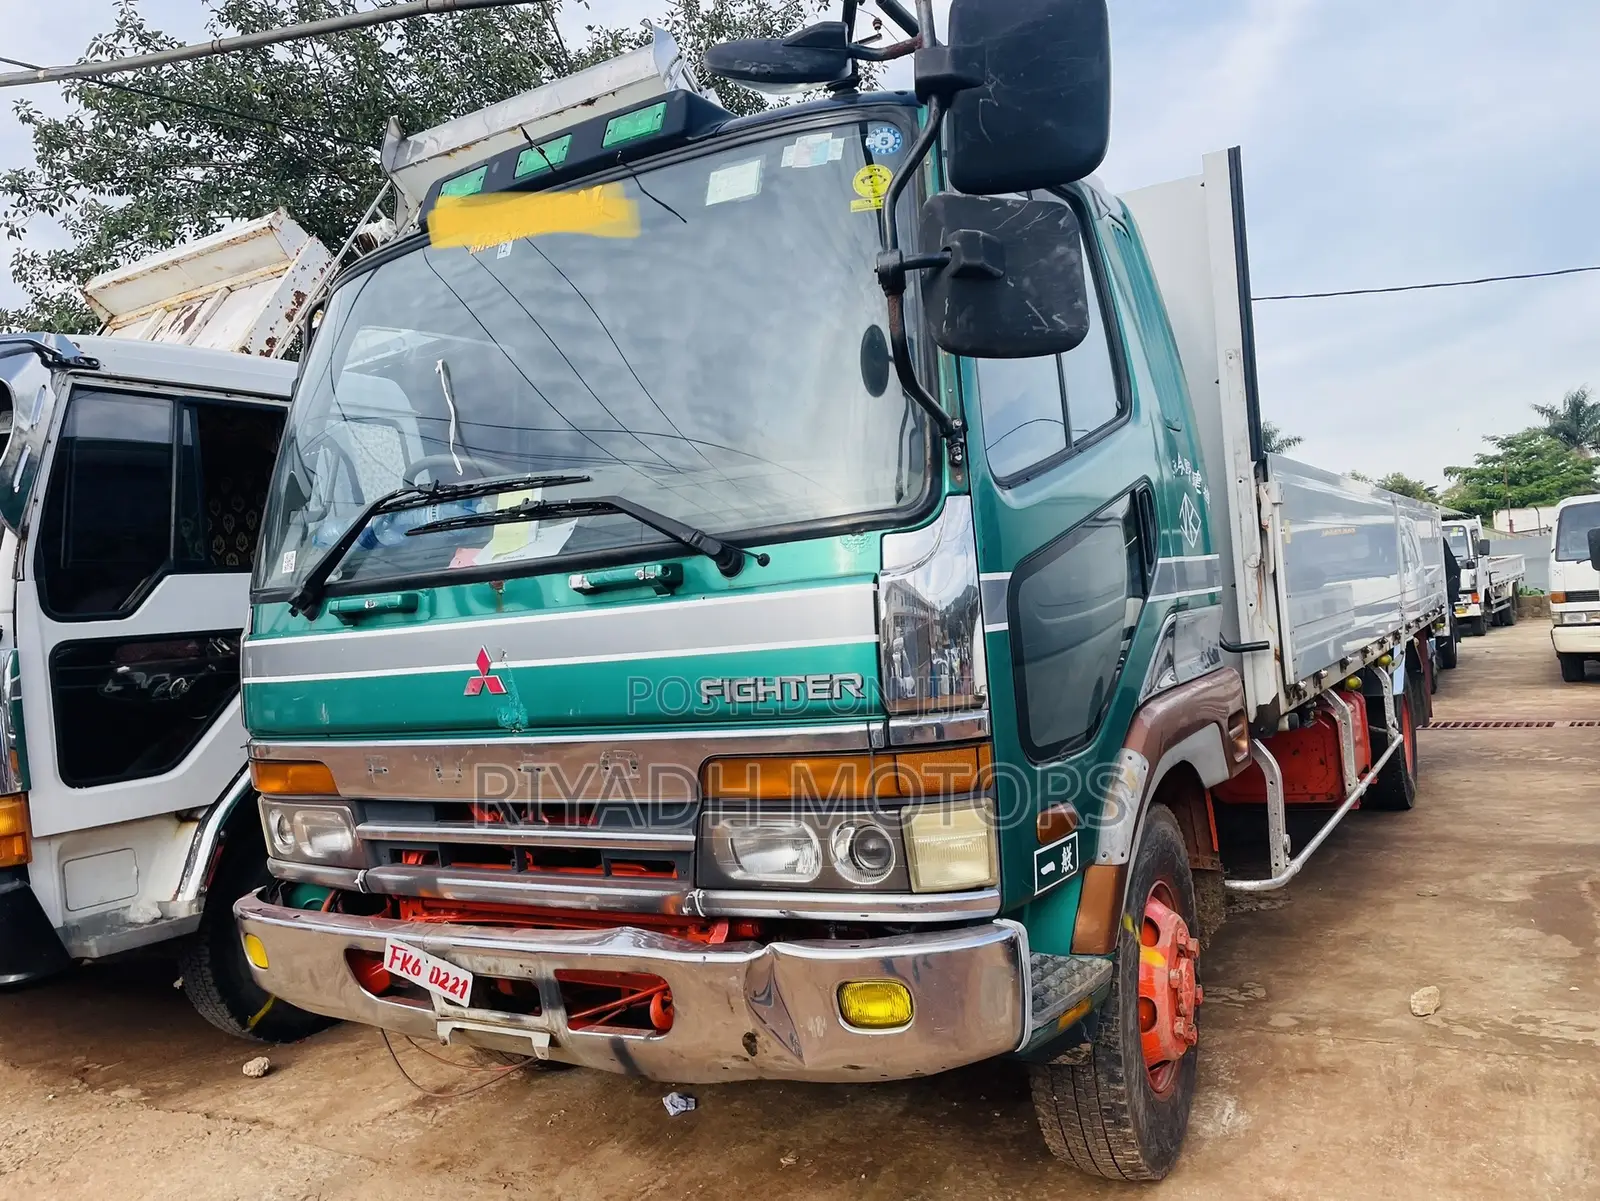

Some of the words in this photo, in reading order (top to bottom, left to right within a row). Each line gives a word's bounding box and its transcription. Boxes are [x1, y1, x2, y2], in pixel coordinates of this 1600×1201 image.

[701, 672, 867, 705] FIGHTER
[1040, 842, 1075, 876] 一般
[389, 944, 422, 977] FK6
[428, 965, 469, 1000] 0221
